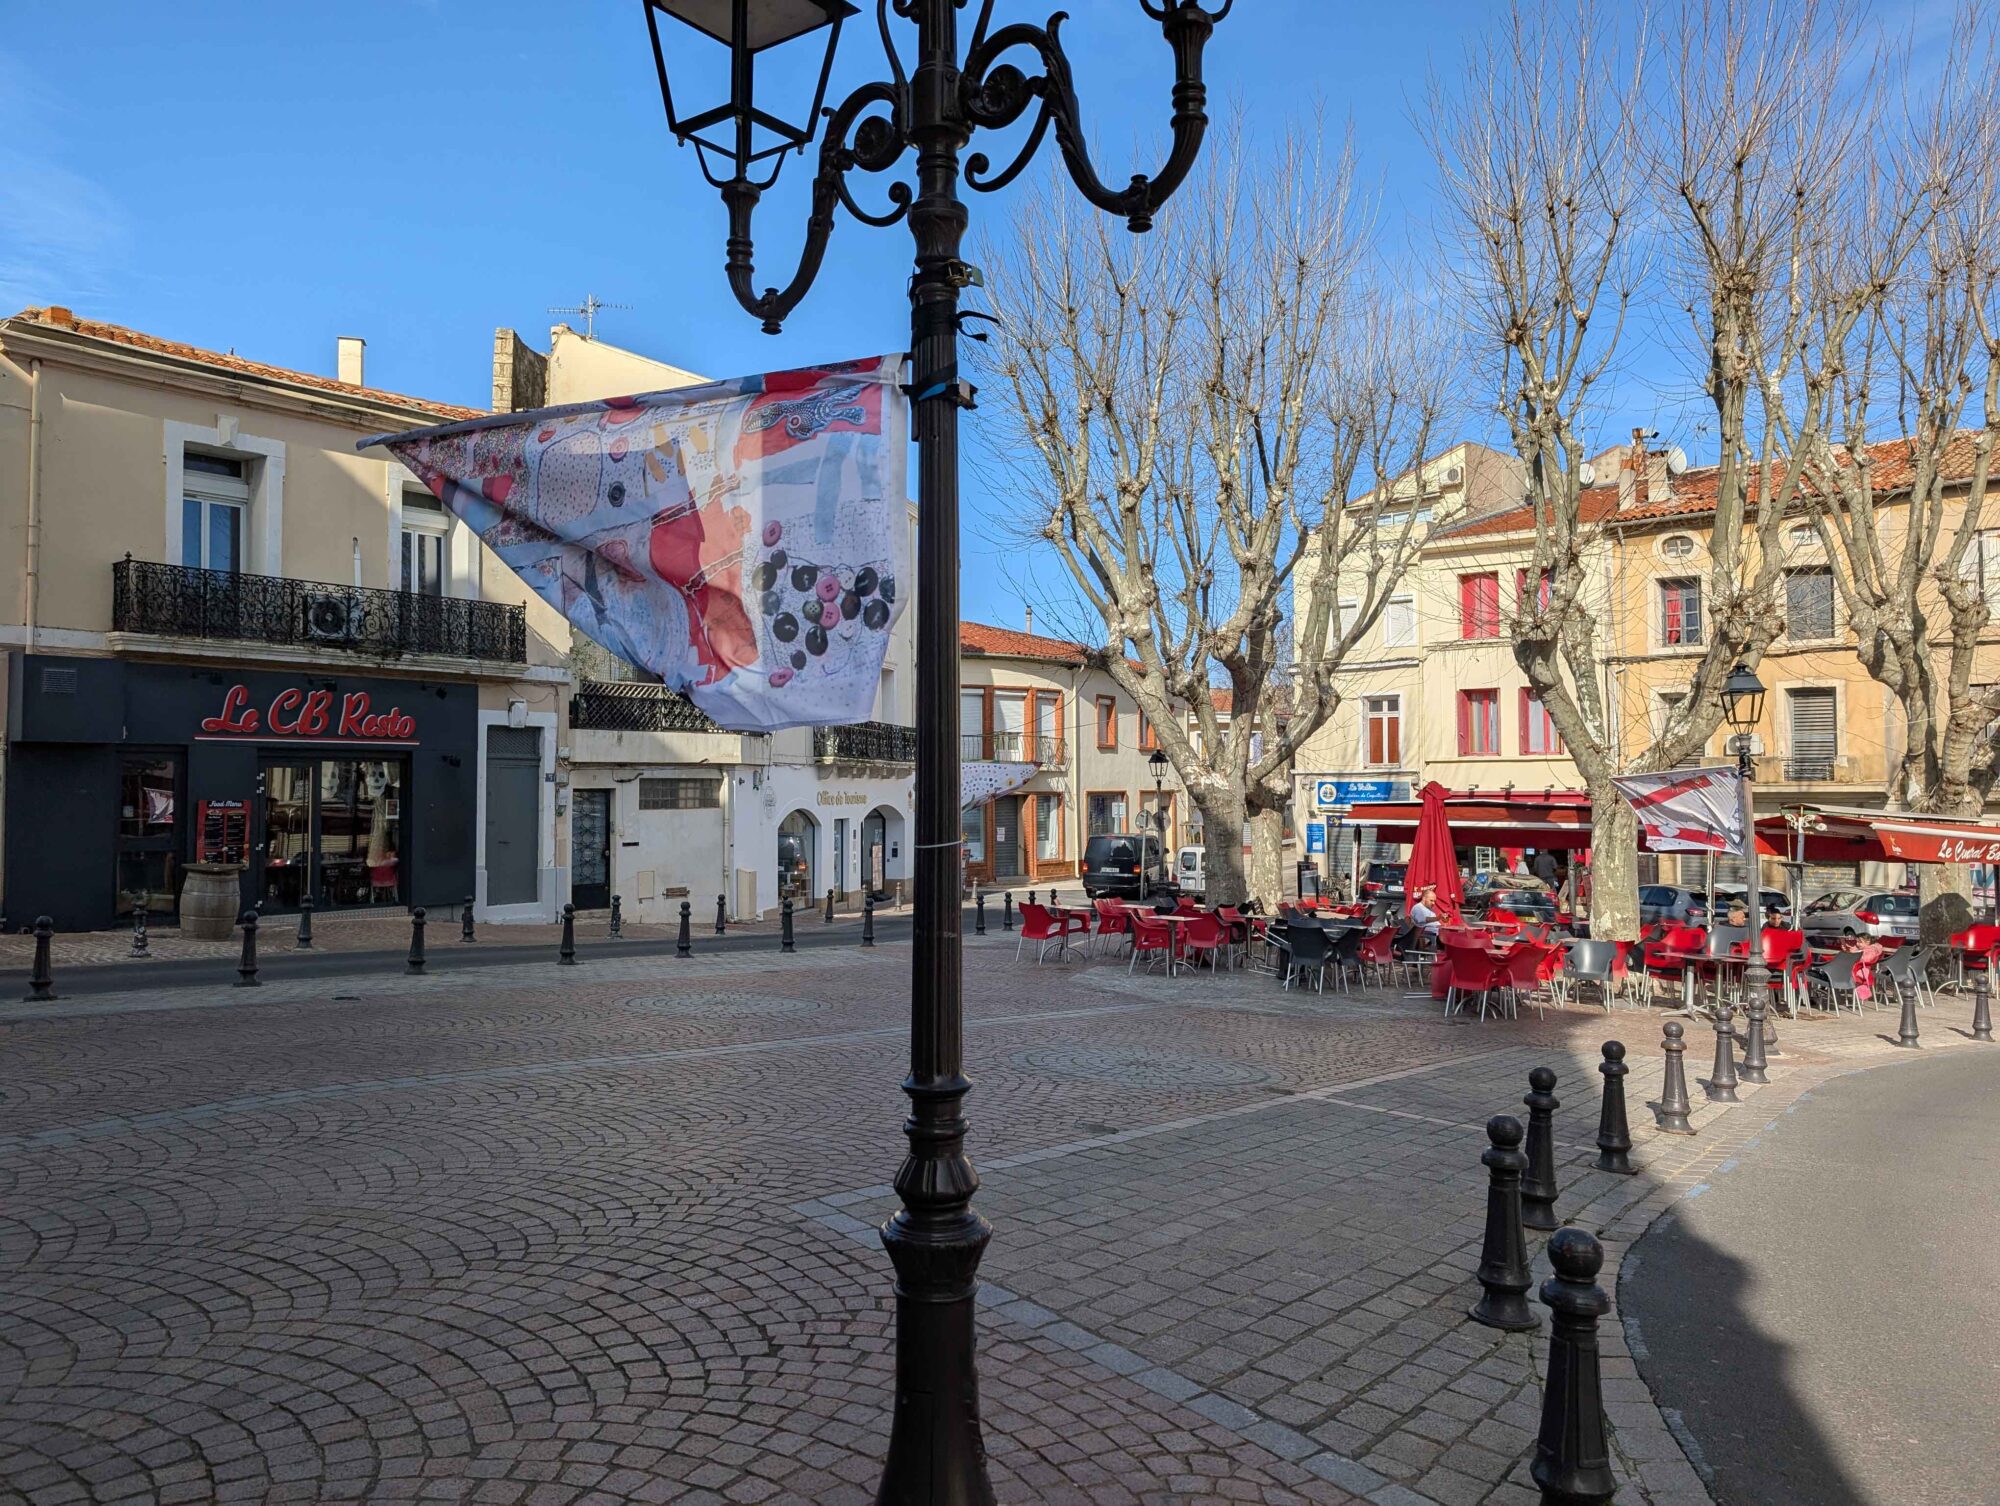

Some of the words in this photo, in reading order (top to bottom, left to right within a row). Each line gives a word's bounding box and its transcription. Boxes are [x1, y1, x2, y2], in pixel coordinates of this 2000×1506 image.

[201, 684, 260, 733] Le
[267, 687, 334, 735] CB
[338, 691, 417, 738] Resto
[817, 790, 835, 806] Office
[835, 790, 844, 806] de
[1937, 838, 1953, 859] Le
